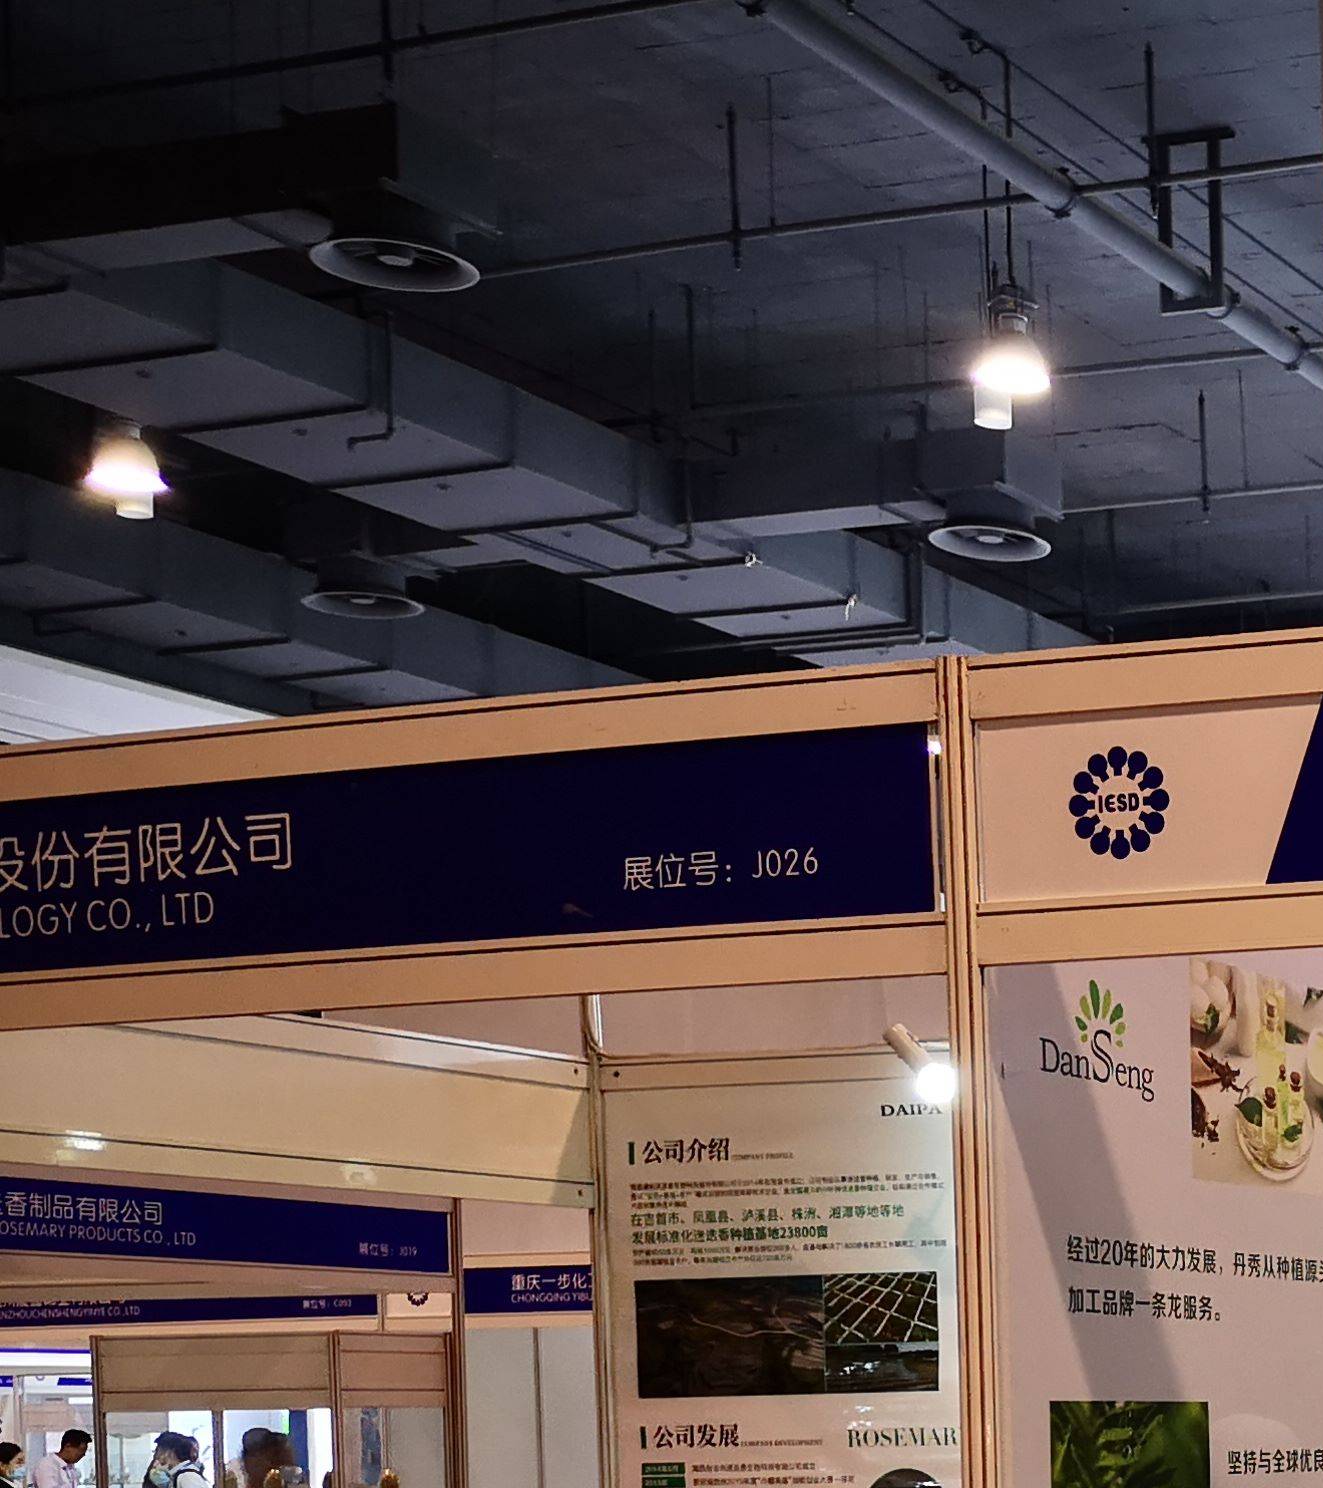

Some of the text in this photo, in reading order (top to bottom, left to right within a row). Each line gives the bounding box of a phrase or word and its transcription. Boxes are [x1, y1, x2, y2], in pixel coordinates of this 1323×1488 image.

[1098, 793, 1139, 813] IESD
[751, 848, 819, 878] J026
[162, 891, 215, 925] LTD
[1039, 1029, 1155, 1103] DanSeng
[642, 1137, 730, 1165] 公司介绍
[0, 1191, 164, 1226] 香制品有限公司
[69, 1224, 141, 1244] PRODUCTS
[1068, 1285, 1223, 1322] 加工品牌一条龙服务。
[653, 1423, 740, 1450] 公司发展
